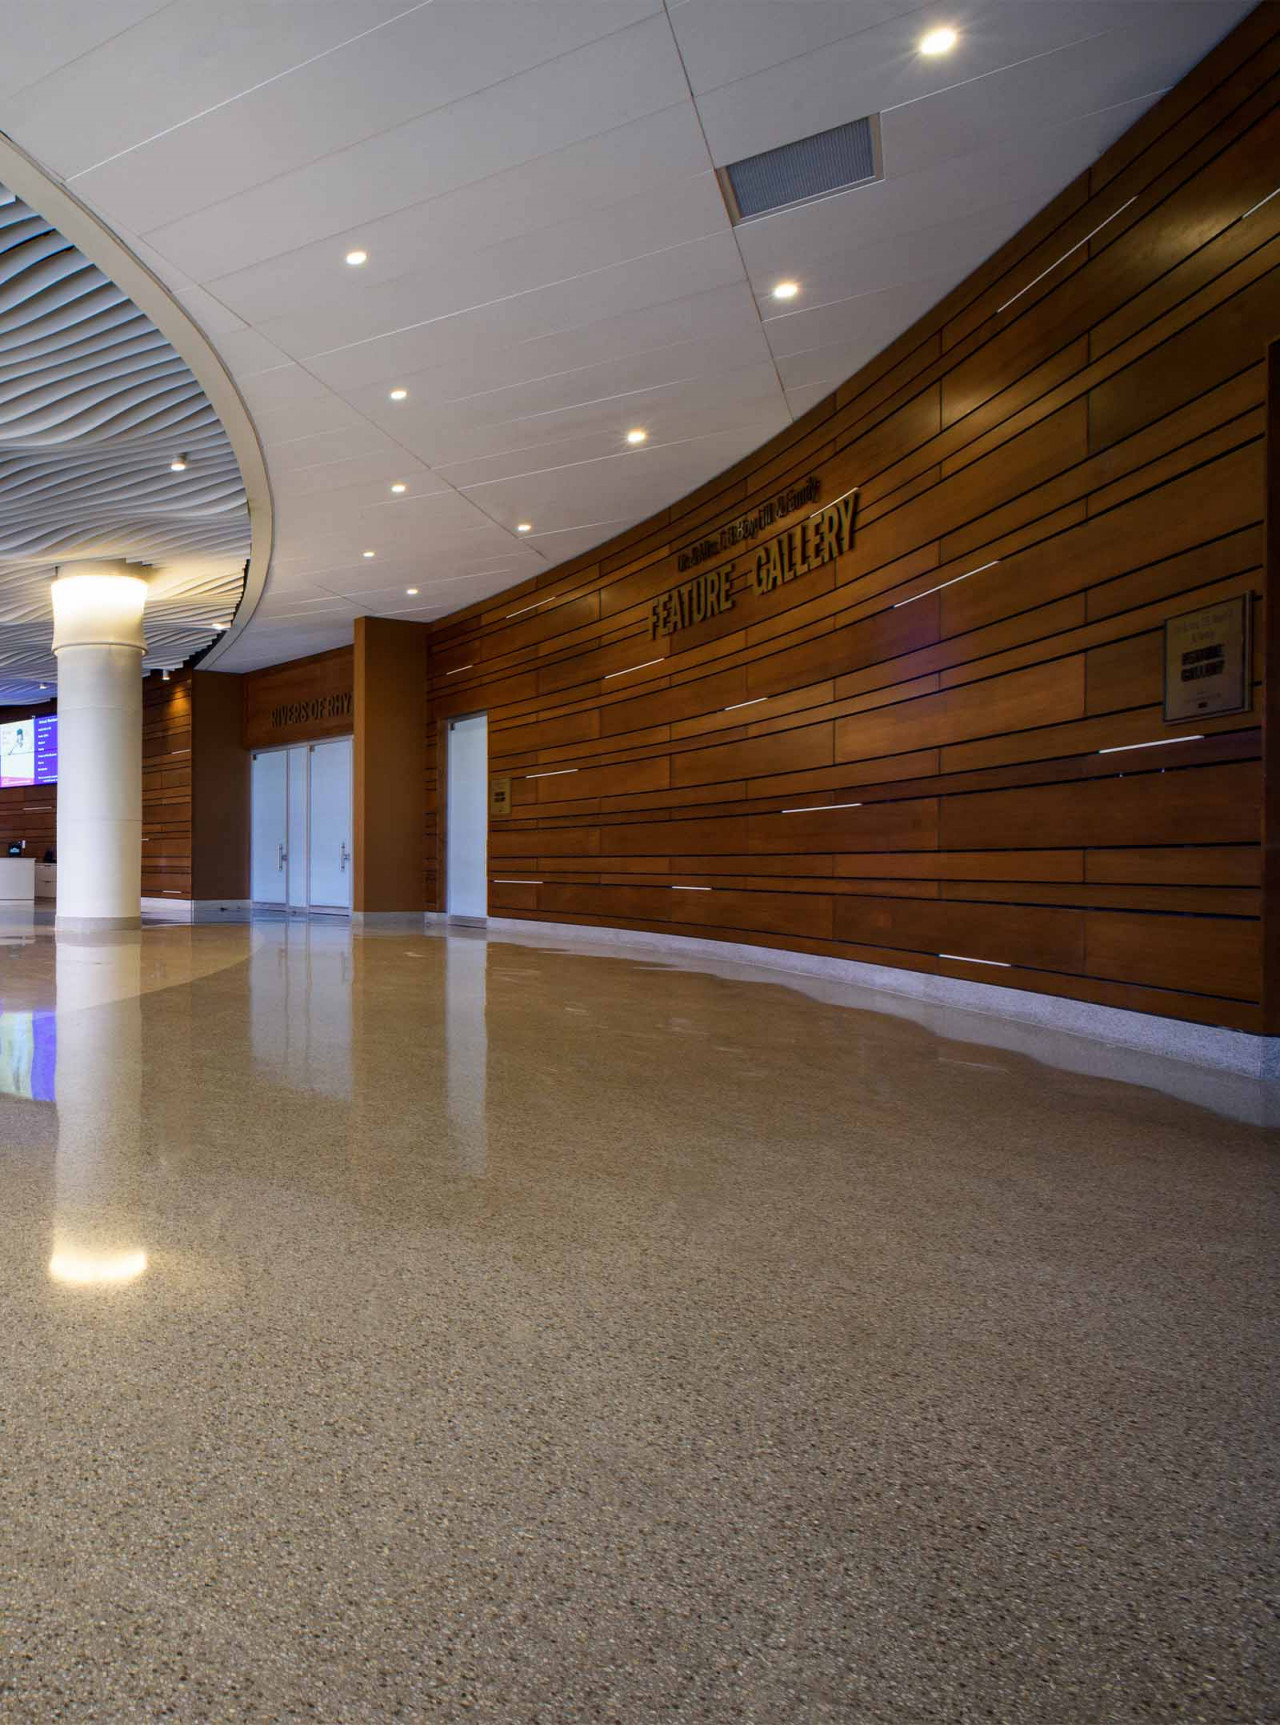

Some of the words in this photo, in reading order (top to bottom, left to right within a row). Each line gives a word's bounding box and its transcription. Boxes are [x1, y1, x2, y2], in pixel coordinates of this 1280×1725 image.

[649, 562, 736, 640] FEATURE
[754, 492, 860, 595] GALLERY
[271, 702, 309, 728] RIVERS
[310, 698, 325, 721] OF
[327, 692, 354, 718] RHY
